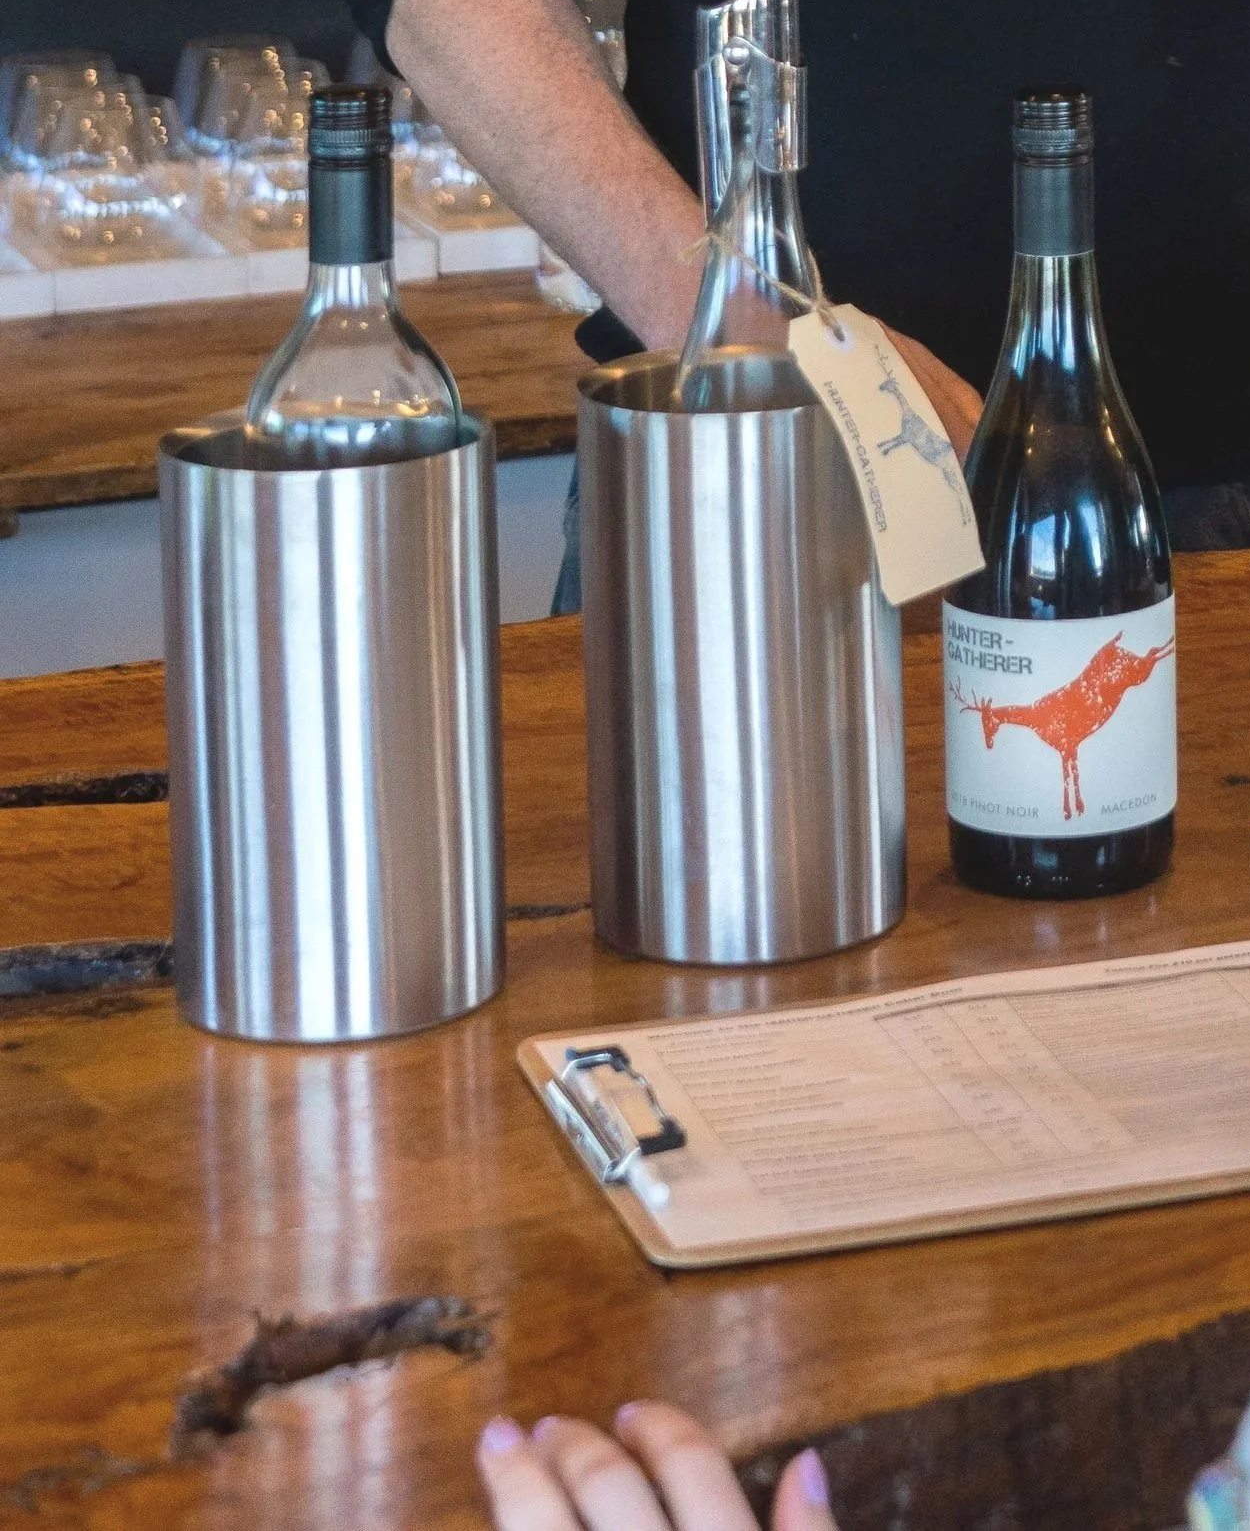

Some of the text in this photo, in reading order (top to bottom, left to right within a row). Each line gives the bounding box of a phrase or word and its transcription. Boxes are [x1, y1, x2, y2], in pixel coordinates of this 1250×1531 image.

[947, 642, 1033, 674] GATHERER
[970, 797, 1001, 814] PINOT
[1006, 805, 1039, 818] NOIR
[1100, 792, 1157, 815] MACEDON
